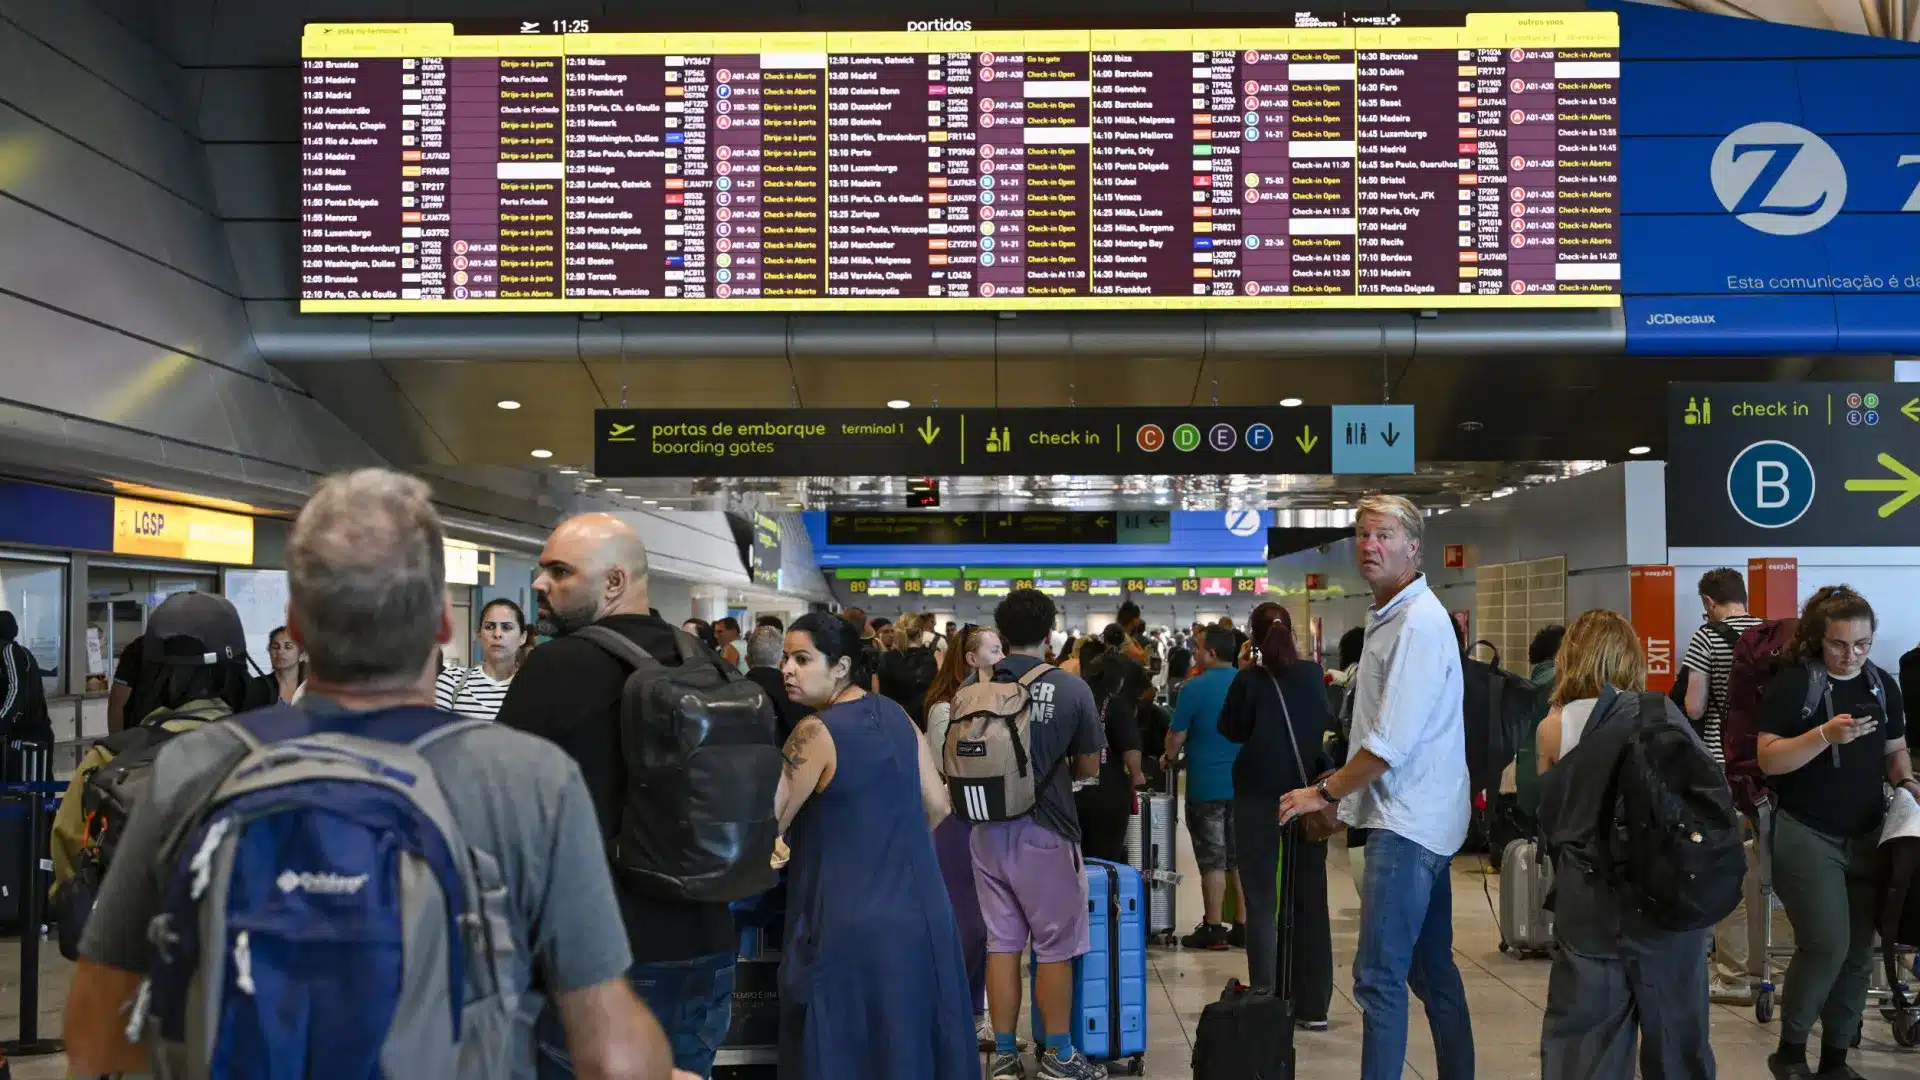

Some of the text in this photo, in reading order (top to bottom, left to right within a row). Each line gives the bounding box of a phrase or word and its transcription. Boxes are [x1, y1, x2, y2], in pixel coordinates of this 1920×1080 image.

[553, 20, 589, 34] 11:25
[907, 18, 972, 32] partidas
[1728, 276, 1764, 288] Esta
[1769, 275, 1883, 290] comunicação
[1889, 275, 1898, 288] é
[1647, 314, 1715, 324] JCDecaux
[1732, 401, 1808, 416] check in
[653, 422, 825, 439] portas de embarque
[842, 424, 903, 434] terminal 1
[1029, 431, 1080, 444] check
[1086, 431, 1099, 444] in
[653, 441, 774, 456] boarding gates
[1757, 461, 1789, 508] B
[135, 511, 164, 536] LGSP
[850, 581, 867, 592] 89
[905, 581, 920, 591] 88
[1016, 580, 1032, 590] 86
[1072, 580, 1089, 591] 85
[1128, 580, 1145, 592] 84
[1182, 580, 1197, 590] 83
[1238, 580, 1256, 592] 82
[1648, 637, 1670, 674] EXIT
